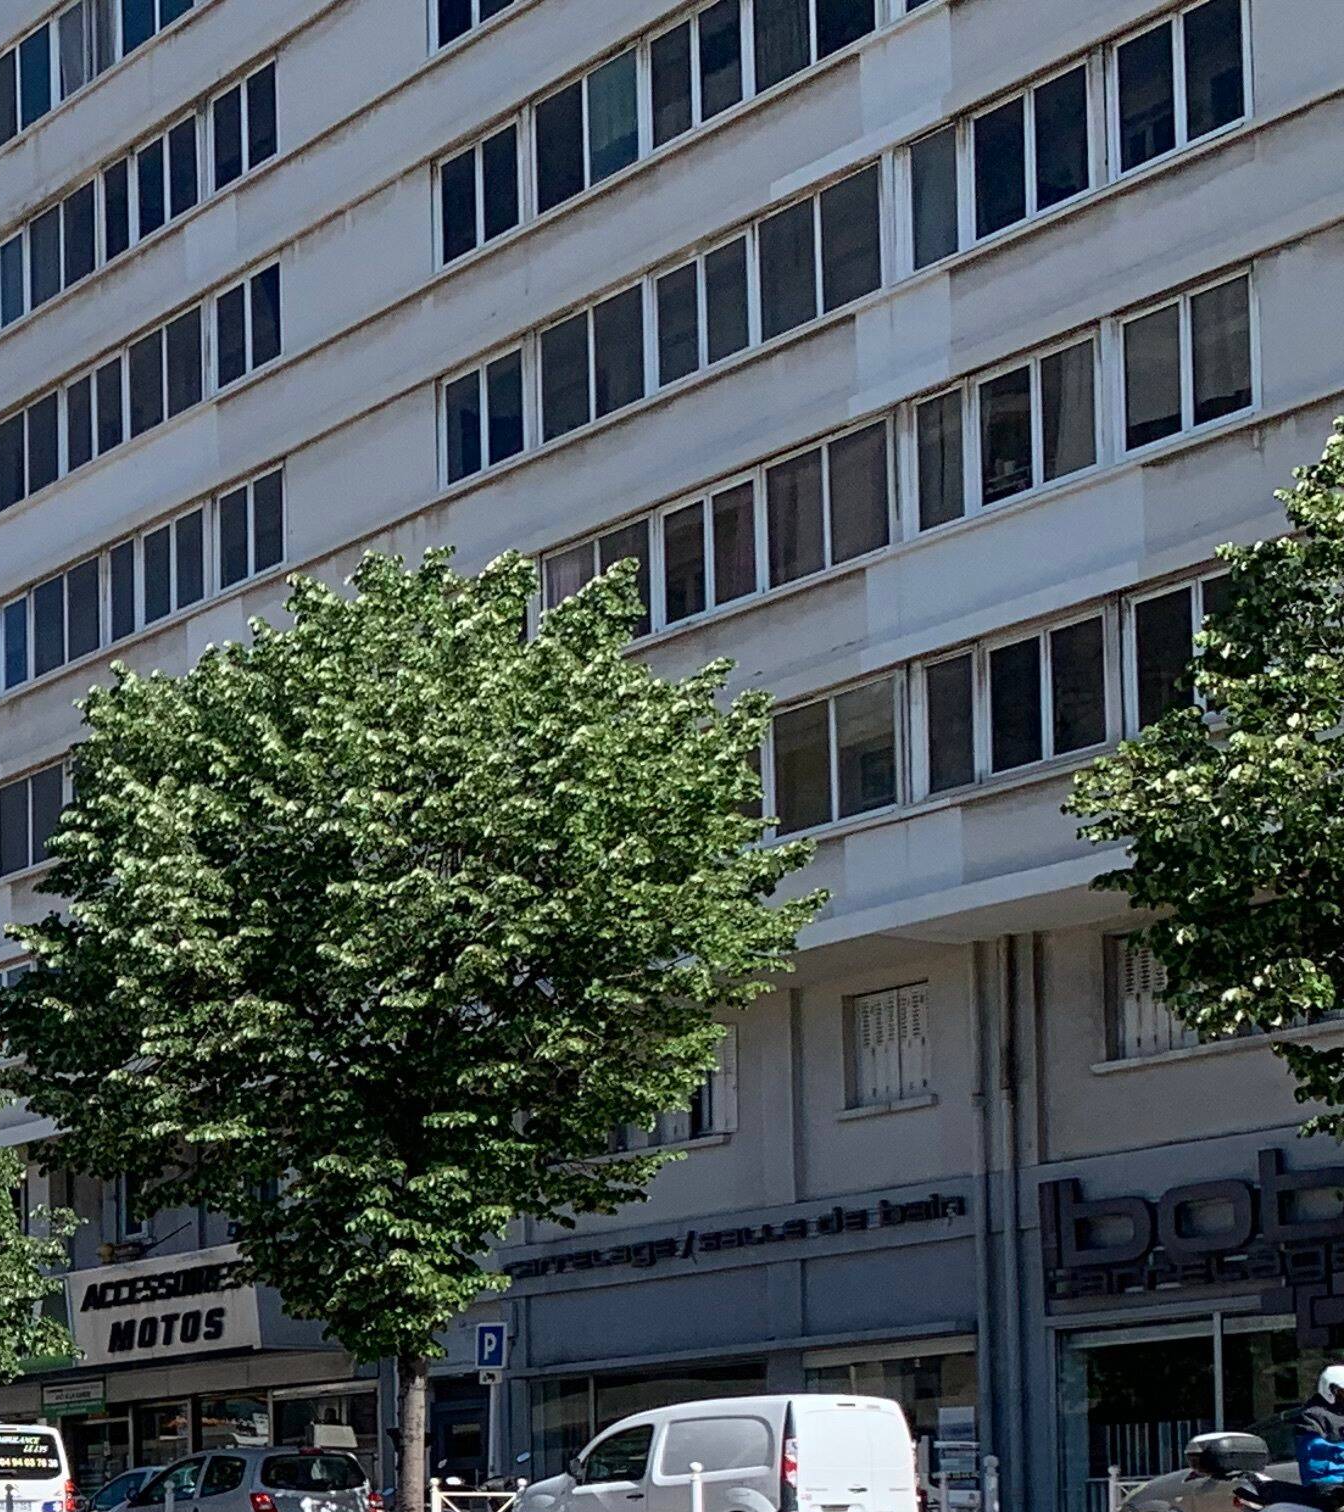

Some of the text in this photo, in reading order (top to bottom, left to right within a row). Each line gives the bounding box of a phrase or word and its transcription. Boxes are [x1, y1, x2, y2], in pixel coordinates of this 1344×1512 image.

[107, 1307, 226, 1353] MOTOS
[483, 1332, 498, 1361] P
[11, 1457, 23, 1468] 94
